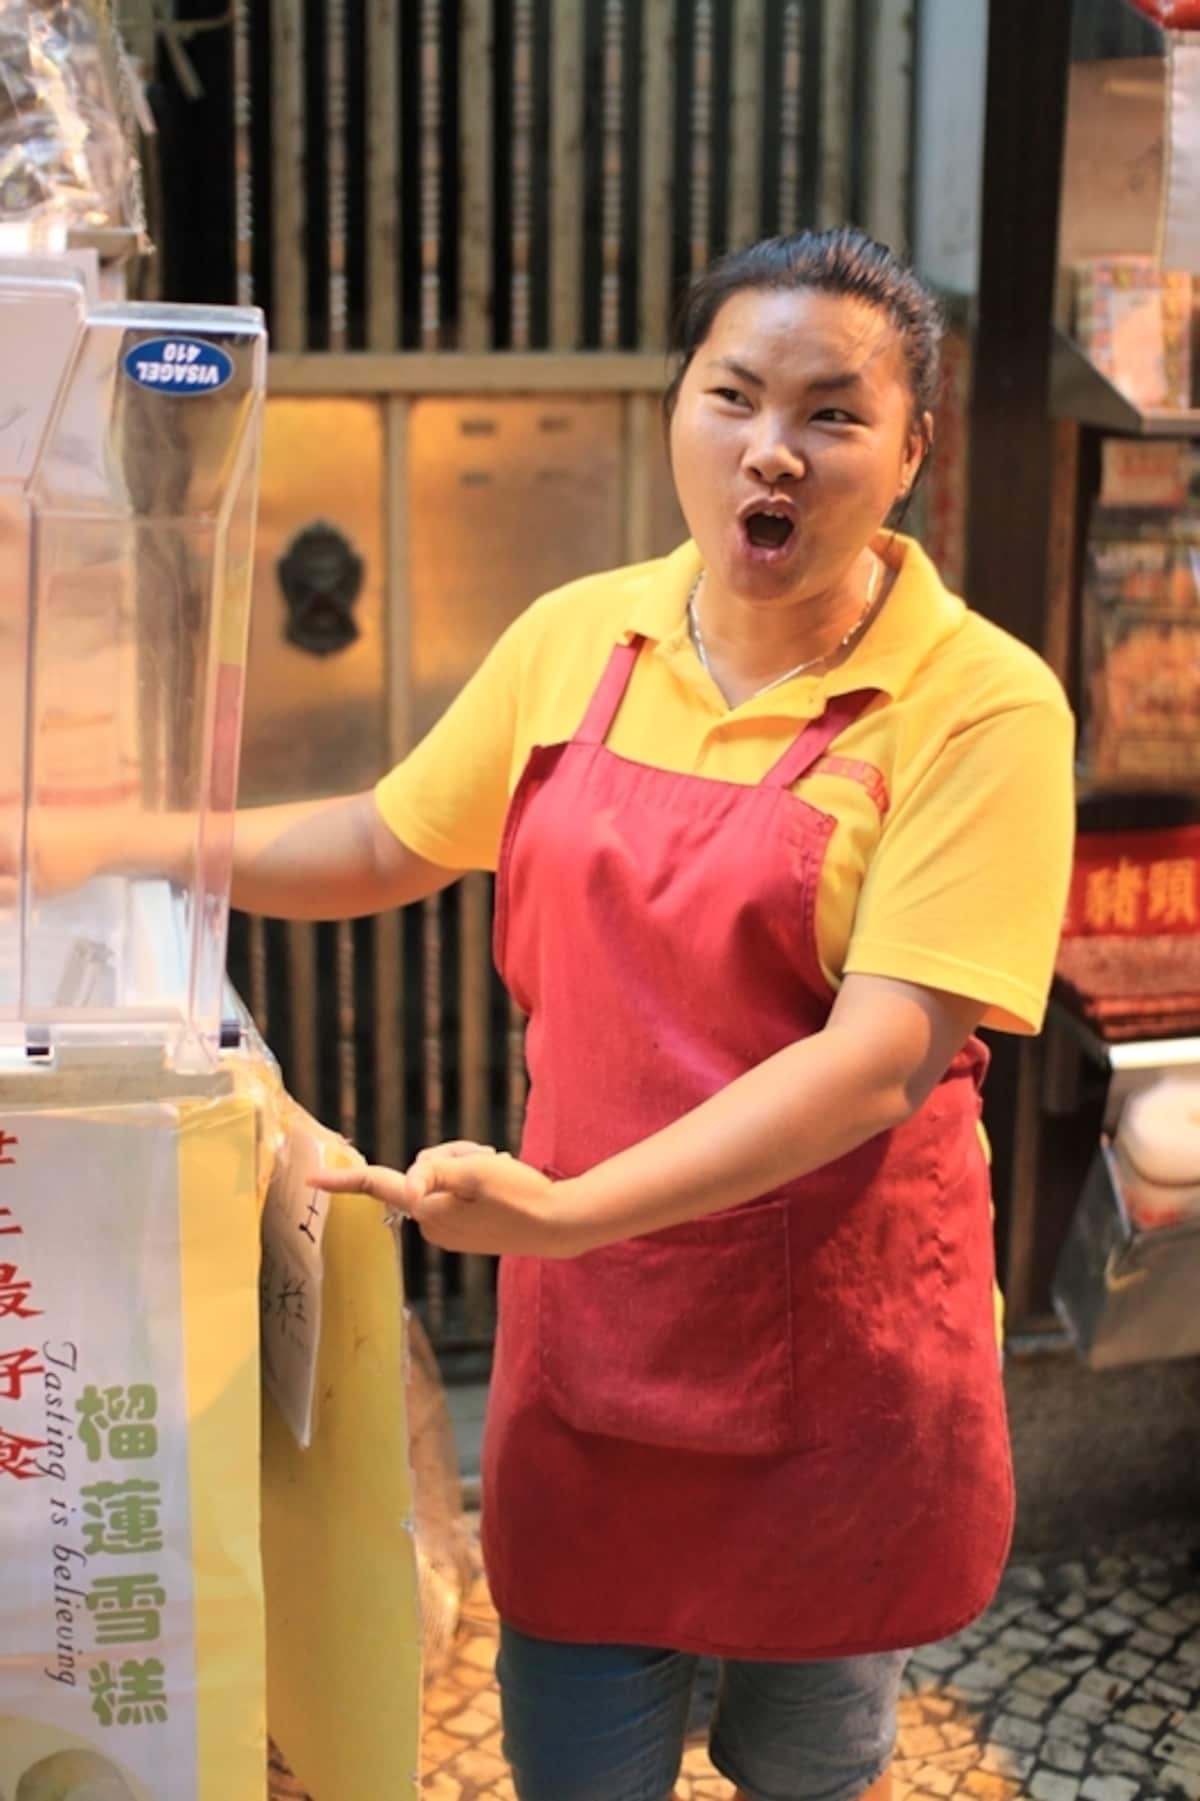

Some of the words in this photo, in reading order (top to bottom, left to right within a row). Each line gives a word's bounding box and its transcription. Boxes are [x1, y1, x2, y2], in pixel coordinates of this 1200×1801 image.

[136, 361, 219, 385] VISAGEL
[163, 343, 201, 363] 410
[32, 1341, 77, 1481] Tasting
[50, 1497, 77, 1527] is
[75, 1383, 168, 1727] 榴蓮雪糕
[44, 1543, 88, 1687] believing
